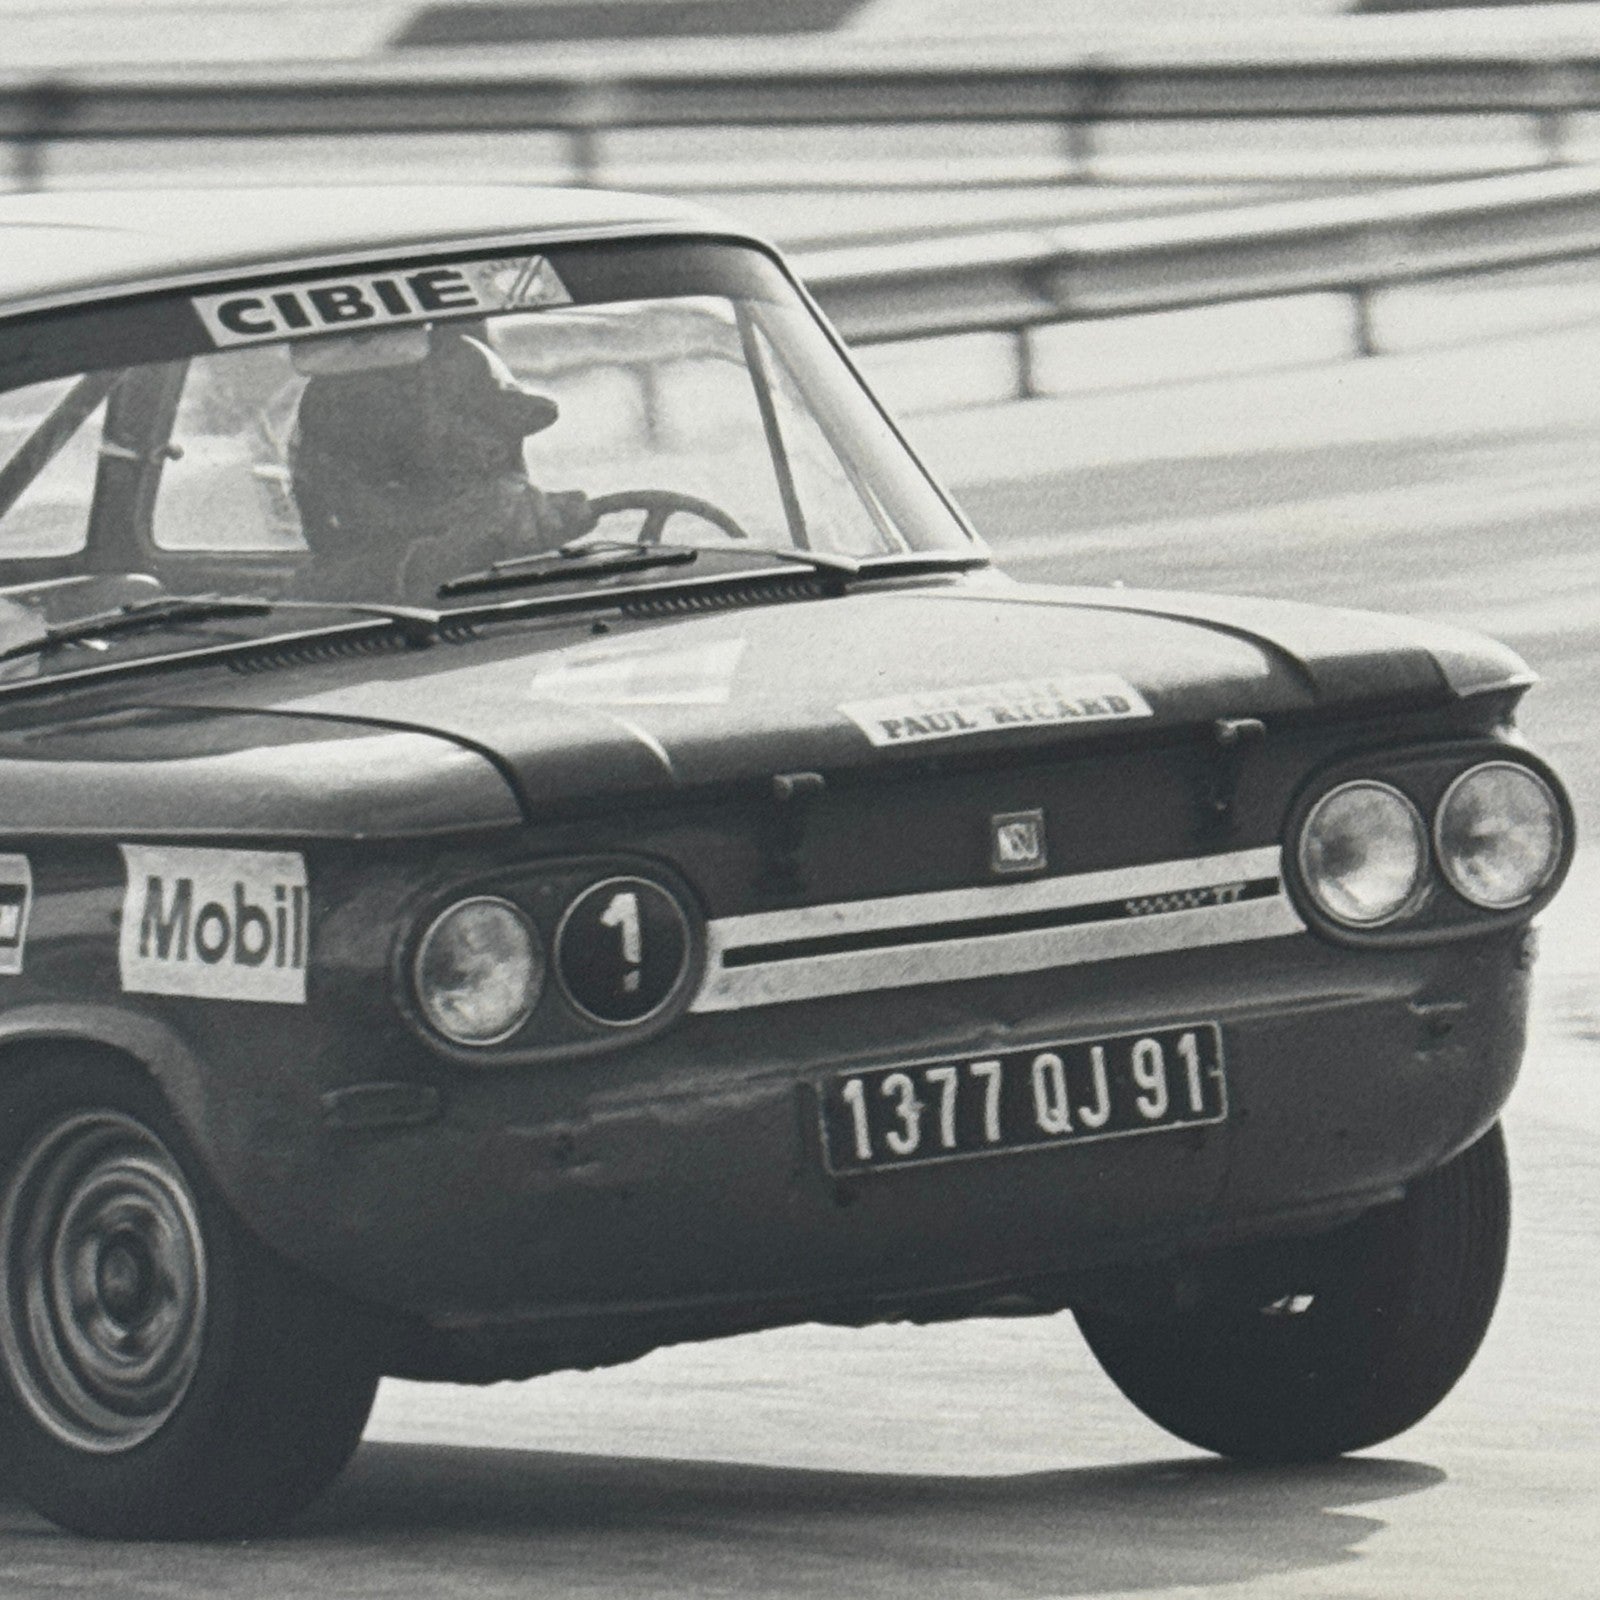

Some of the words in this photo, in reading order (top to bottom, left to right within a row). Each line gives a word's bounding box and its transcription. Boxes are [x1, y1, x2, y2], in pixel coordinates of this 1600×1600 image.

[878, 710, 978, 740] PAUL
[139, 874, 304, 970] Mobil
[842, 1061, 1002, 1160] 1377
[1031, 1046, 1111, 1134] QJ
[1131, 1033, 1204, 1120] 91
